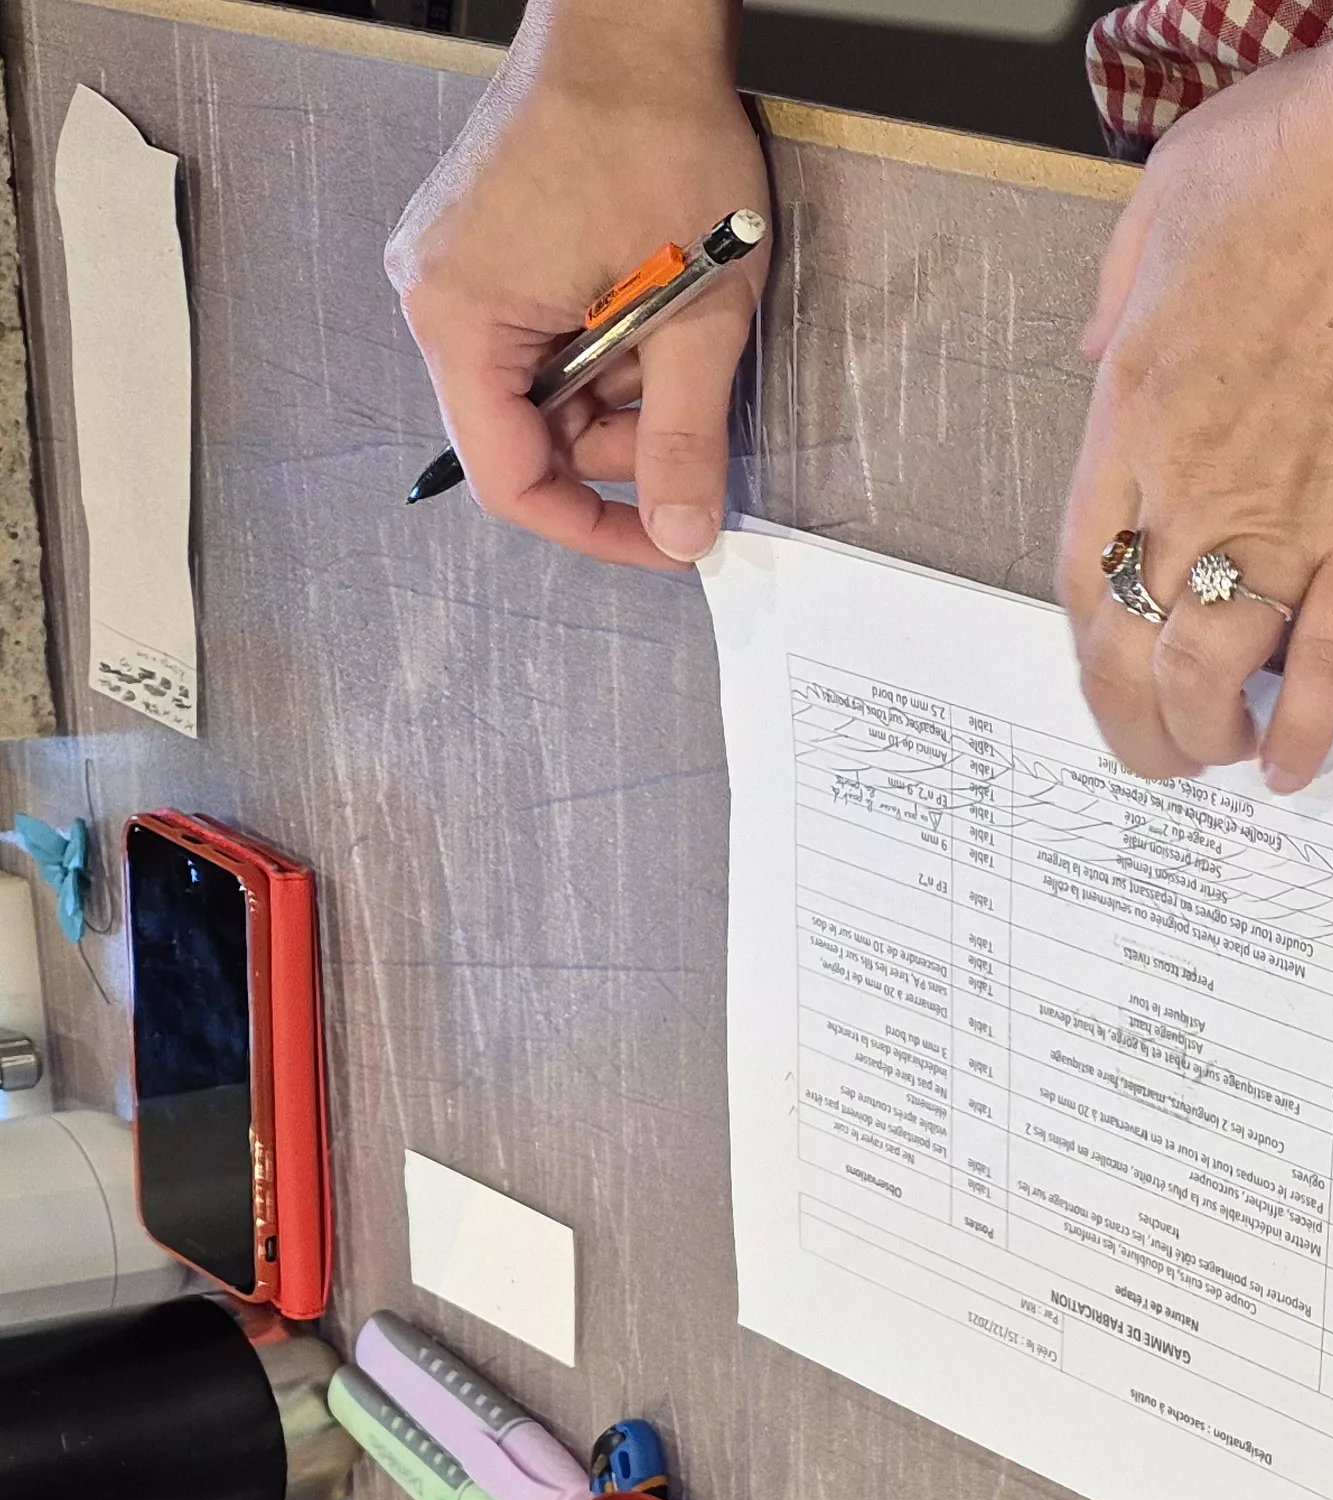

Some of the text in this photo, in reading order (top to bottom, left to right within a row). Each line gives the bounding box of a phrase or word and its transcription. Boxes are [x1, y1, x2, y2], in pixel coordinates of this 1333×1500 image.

[1024, 1122, 1322, 1259] Mettre indéchirable sur la plus étroite, encoller en pleins les 2
[1187, 1170, 1324, 1235] pièces, afficher, surcouper
[963, 1215, 995, 1240] Postes
[1017, 1179, 1313, 1316] Reporter les pointages côté fleur, les crans de montage sur les
[1063, 1221, 1258, 1316] Coupe des cuirs, la doublure, les renforts
[1050, 1290, 1192, 1365] GAMME DE FABRICATION
[1114, 1284, 1200, 1333] Nature de l'étape
[1129, 1388, 1158, 1409] outils
[1158, 1401, 1167, 1416] à
[1166, 1405, 1206, 1432] sacoche
[1212, 1427, 1273, 1464] Désignation
